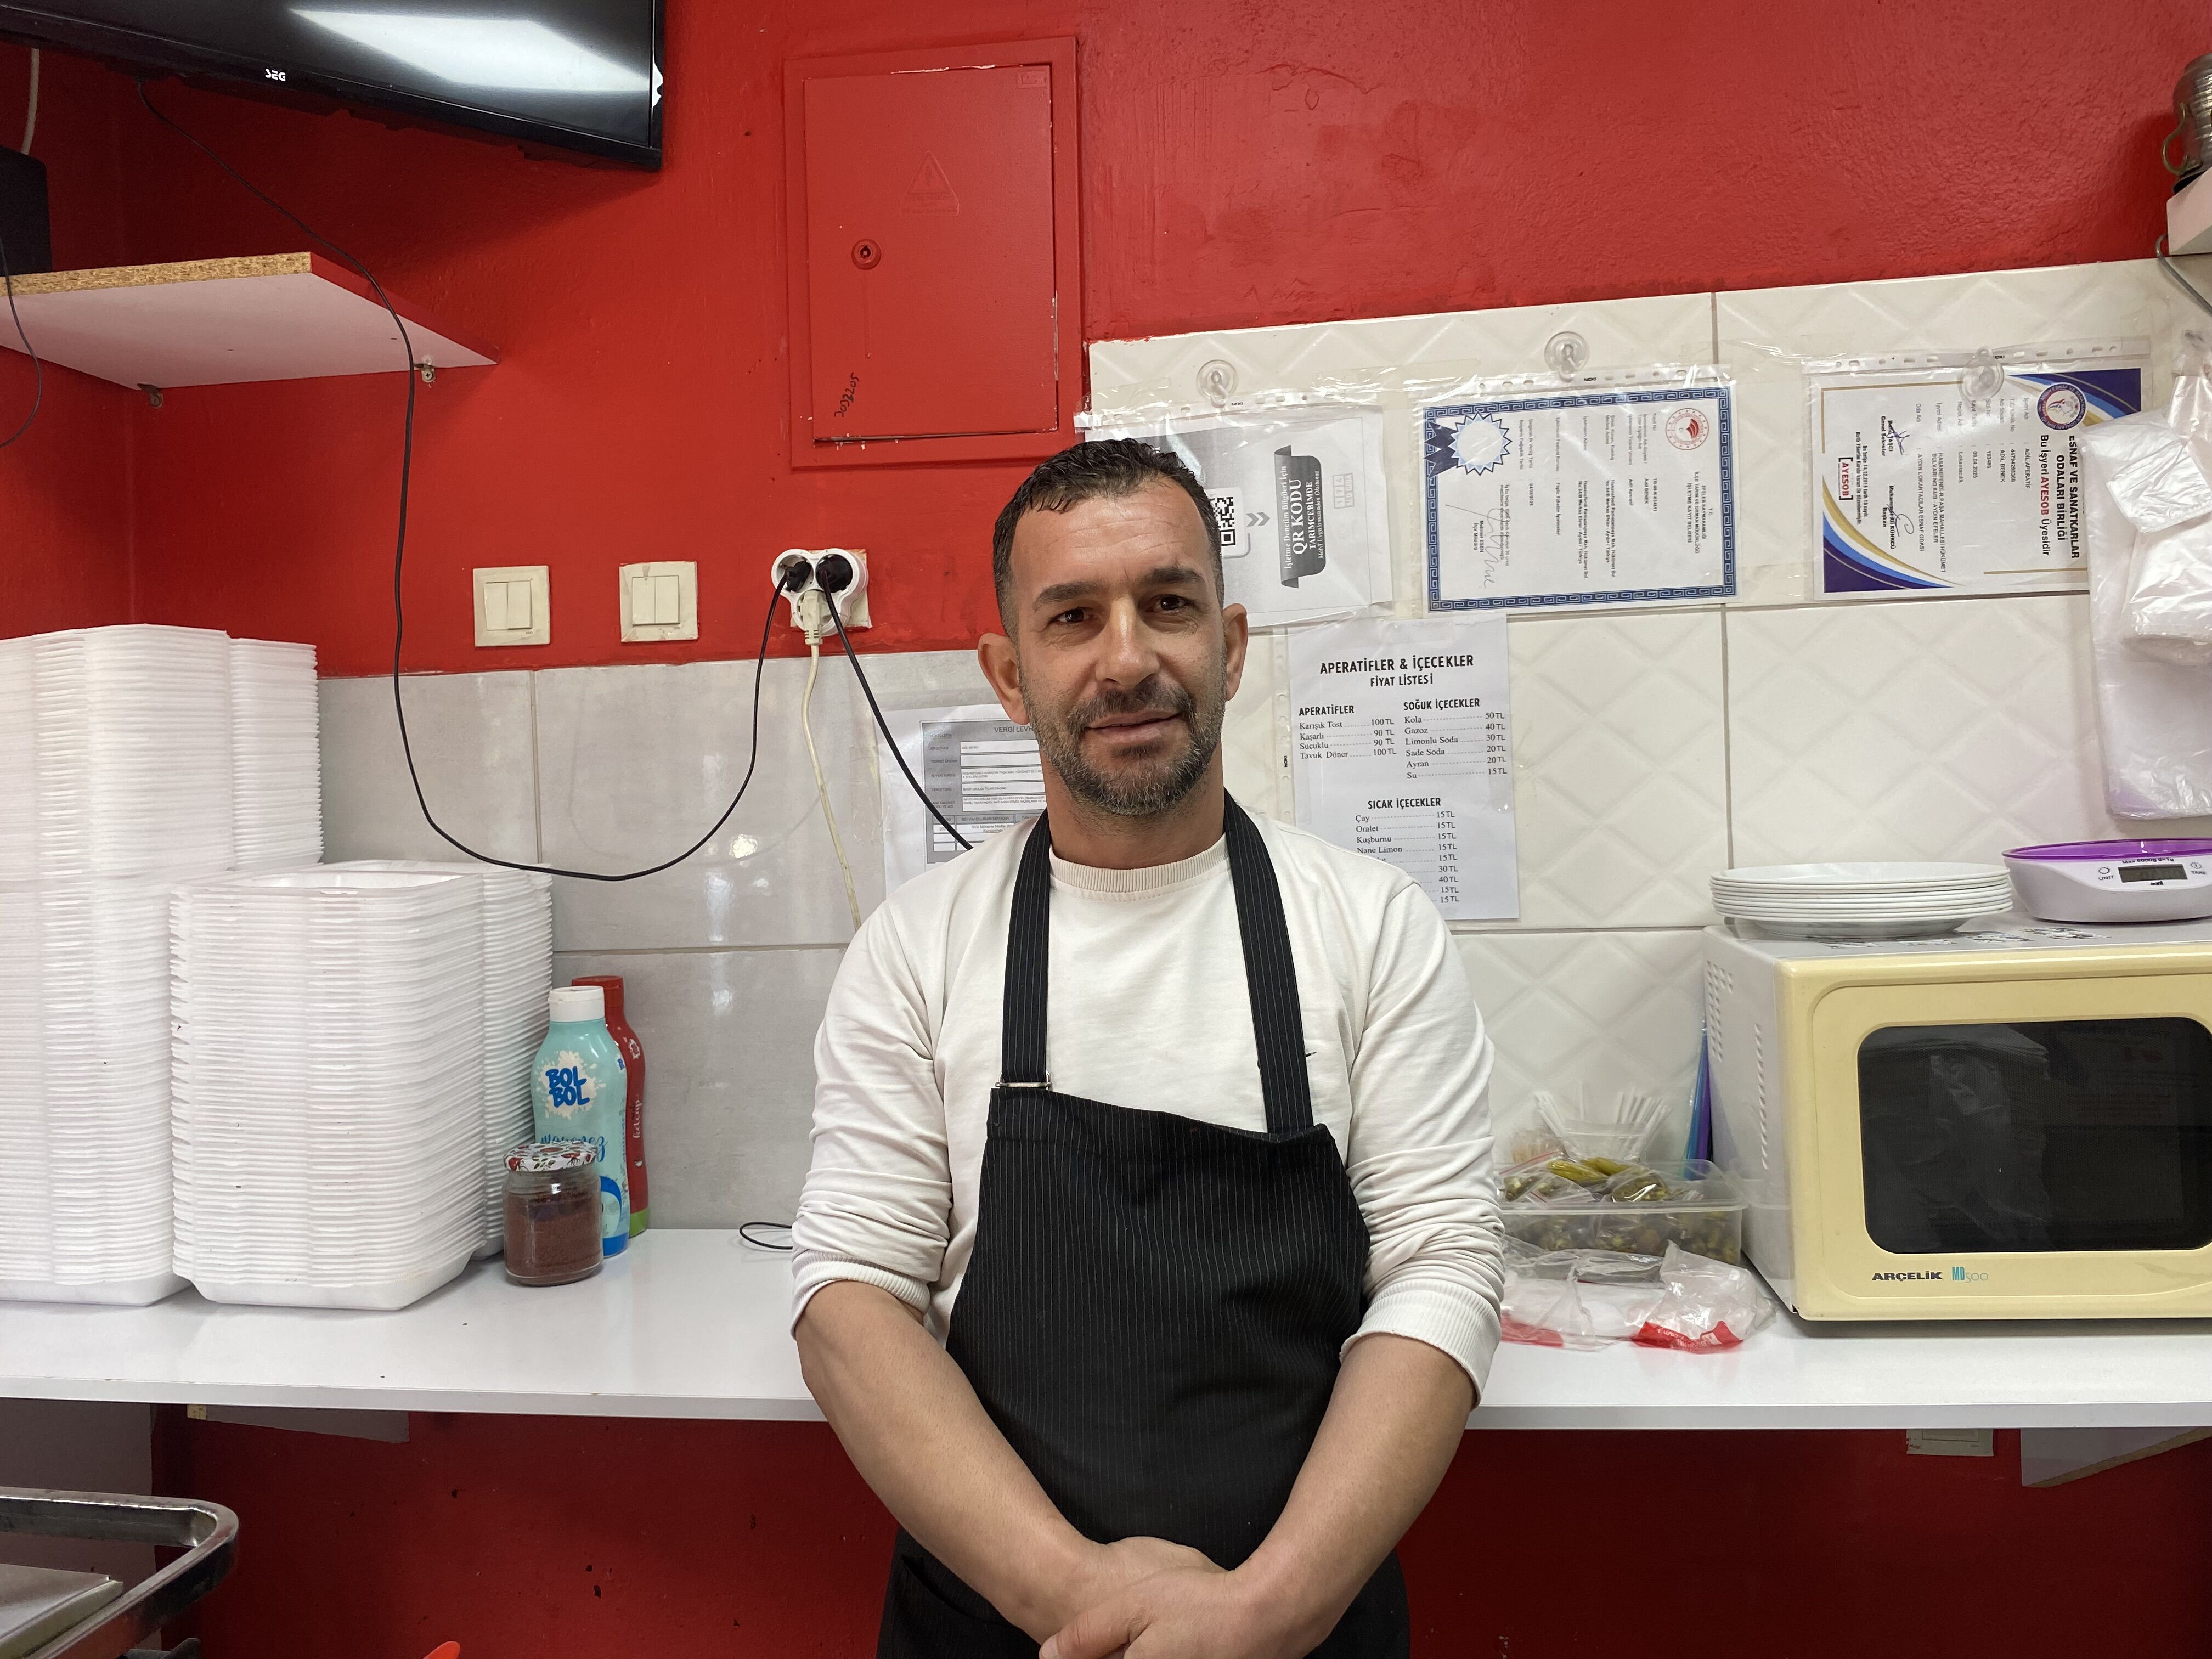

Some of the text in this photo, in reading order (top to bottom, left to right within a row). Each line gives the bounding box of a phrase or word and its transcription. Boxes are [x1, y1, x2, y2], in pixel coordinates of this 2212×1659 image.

[265, 69, 286, 81] SEG
[2039, 435, 2051, 555] Bu İşyeri AYESOB Üyesidir
[2057, 455, 2068, 540] ODALARI BİRLİĞİ
[2069, 435, 2079, 558] ESNAF VE SANATKARLAR
[1289, 479, 1307, 555] QR KODU
[1306, 481, 1316, 550] TARIMCEBİMDE
[1320, 654, 1474, 674] APERATİFLER & İÇECEKLER
[1370, 673, 1433, 687] FİYAT LİSTESİ
[1299, 704, 1354, 716] APERATİFLER
[1403, 698, 1480, 710] SOĞUK İÇECEKLER
[1300, 722, 1325, 730] Karışık
[1368, 797, 1441, 809] SICAK İÇECEKLER
[545, 1066, 587, 1088] BOL
[549, 1085, 590, 1108] BOL
[1872, 1271, 1943, 1282] ARÇELİK
